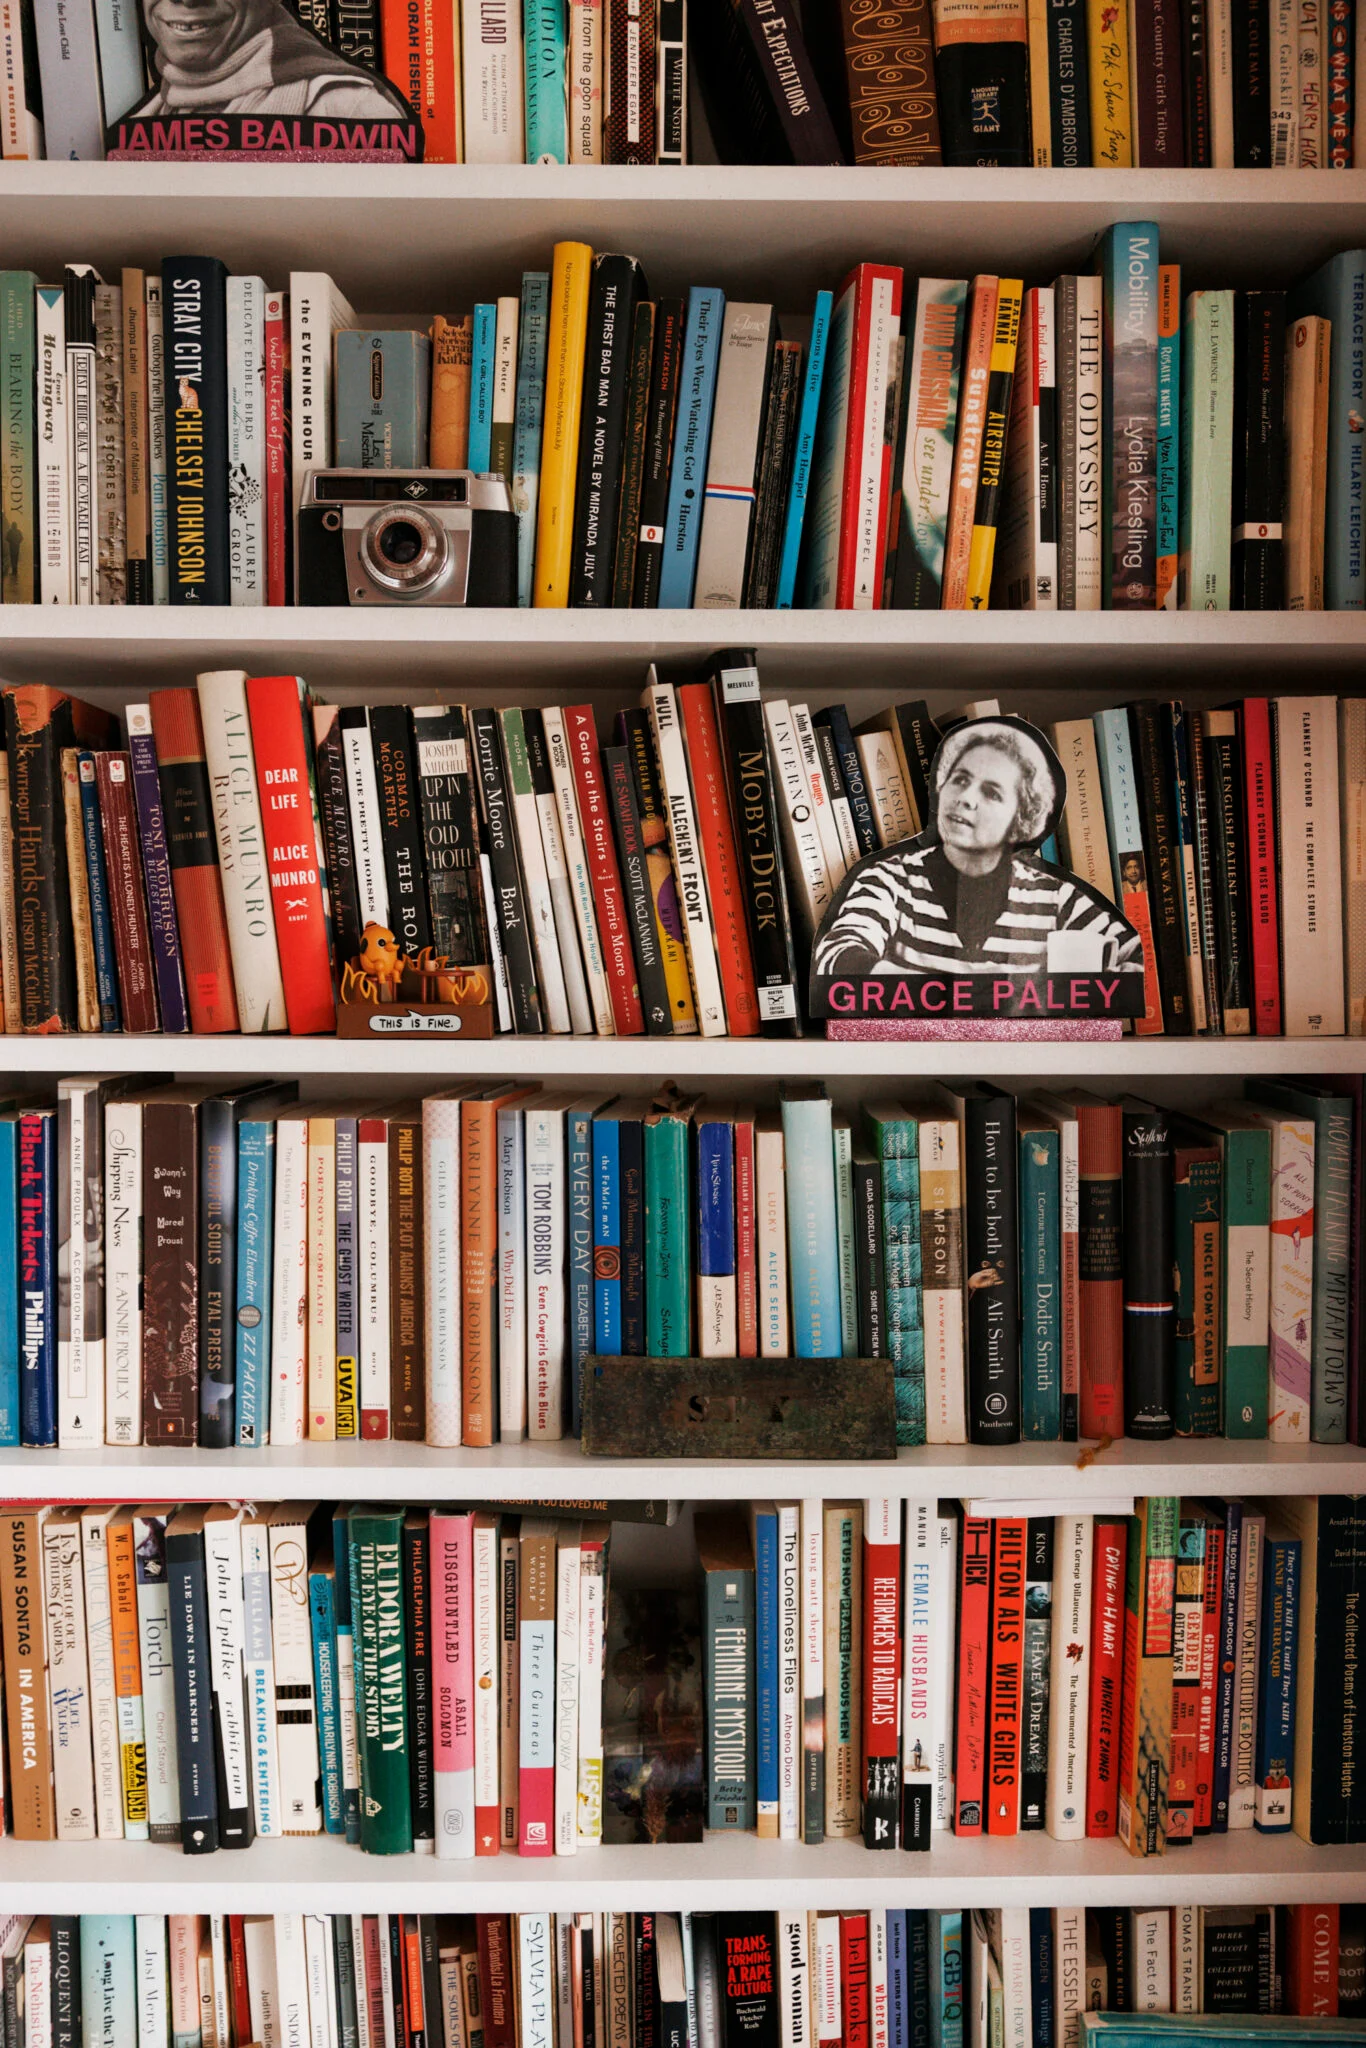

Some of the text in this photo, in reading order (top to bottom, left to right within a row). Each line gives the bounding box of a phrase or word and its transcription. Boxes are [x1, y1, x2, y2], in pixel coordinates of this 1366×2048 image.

[580, 17, 593, 156] from the goon squad
[629, 29, 637, 87] JENNIFER
[672, 58, 683, 144] WHITE NOISE
[761, 17, 810, 116] EXPECTATIONS
[1058, 18, 1077, 167] CHARLES D'AMBROSIO
[1153, 16, 1167, 154] Country Girls Trilogy
[249, 119, 416, 149] BALDWIN
[1102, 43, 1124, 162] Pik-Shuen Fung
[173, 279, 202, 382] STRAY CITY
[129, 307, 140, 494] Jhumpa Lahiri Interpreter of Maladies
[301, 299, 311, 460] the EVENING HOUR
[1122, 238, 1149, 568] Mobility Lydia Kiesling
[584, 286, 616, 579] THE FIRST BAD MAN A NOVEL BY MIRANDA JULY
[676, 299, 711, 552] Their Eyes Were Watching God Hurston
[982, 411, 1006, 486] AIRSHIPS
[1079, 310, 1099, 537] THE ODYSSEY
[175, 408, 205, 583] CHELSEY JOHNSON
[232, 528, 241, 584] GROFF
[245, 523, 255, 590] LAUREN
[265, 770, 298, 784] DEAR
[1303, 713, 1311, 757] FLANNERY
[214, 775, 235, 874] RUNAWAY
[223, 709, 267, 937] ALICE MUNRO
[271, 795, 299, 809] LIFE
[380, 742, 397, 828] McCARTHY
[394, 750, 410, 818] CORMAC
[478, 725, 520, 929] Lorrie Moore Bark
[149, 805, 175, 958] TONI MORRISON
[271, 870, 316, 887] MUNRO
[273, 845, 309, 860] ALICE
[575, 715, 628, 976] A Gate at the Stairs Lorrie Moore
[739, 750, 777, 930] MOBY-DICK
[1307, 844, 1315, 890] COMPLETE
[396, 848, 419, 957] THE ROA
[1308, 894, 1316, 933] STORIES
[378, 1018, 403, 1029] THIS
[411, 1019, 423, 1028] IS
[828, 980, 1120, 1011] GRACE PALEY
[399, 1129, 413, 1195] PHILIP ROTH
[21, 1116, 43, 1370] Black Tickets Phillips
[985, 1121, 1004, 1380] How to be both Ali Smith
[1244, 1250, 1253, 1320] The Secret History
[208, 1291, 221, 1370] EYAL PRESS
[534, 1183, 551, 1429] TOM ROBBINS Even Cowgirls Get the Blues
[1035, 1283, 1052, 1391] Dodie Smith
[1204, 1232, 1213, 1374] UNCLE TOM'S CABIN
[444, 1542, 459, 1663] DISGRUNTLED
[1104, 1547, 1121, 1590] CRYING
[12, 1521, 36, 1769] SUSAN SONTAG IN AMERICA
[146, 1609, 171, 1676] Torch
[376, 1543, 405, 1754] EUDORA WELTY
[785, 1532, 796, 1694] The Loneliness Files
[872, 1577, 896, 1724] REFORMERS TO RADICALS
[911, 1564, 929, 1719] FEMALE HUSBANDS
[1103, 1622, 1115, 1658] MART
[1105, 1607, 1117, 1617] H
[993, 1528, 1021, 1785] HILTON ALS WHITE GIRLS
[440, 1687, 451, 1747] SOLOMON
[456, 1698, 466, 1736] ASALI
[714, 1628, 746, 1783] FEMININE MYSTIQUE
[1100, 1676, 1114, 1733] MICHELLE
[127, 1744, 136, 1788] BOOKSTORE
[1099, 1739, 1112, 1781] ZAUNER
[527, 1922, 544, 1997] SYLVIA
[727, 1952, 771, 1964] FORMING
[727, 1967, 773, 1980] A RAPE
[1146, 1921, 1157, 1946] The
[1146, 1951, 1157, 1978] Fact
[1313, 1914, 1330, 1984] COME
[57, 1931, 71, 2025] ELOQUENT
[727, 1983, 773, 1996] CULTURE
[785, 1924, 805, 2043] good woman
[824, 1944, 836, 2024] communion
[848, 1936, 865, 2042] bell hooks
[943, 1935, 961, 2020] LGBTQ
[1148, 1984, 1158, 1998] of
